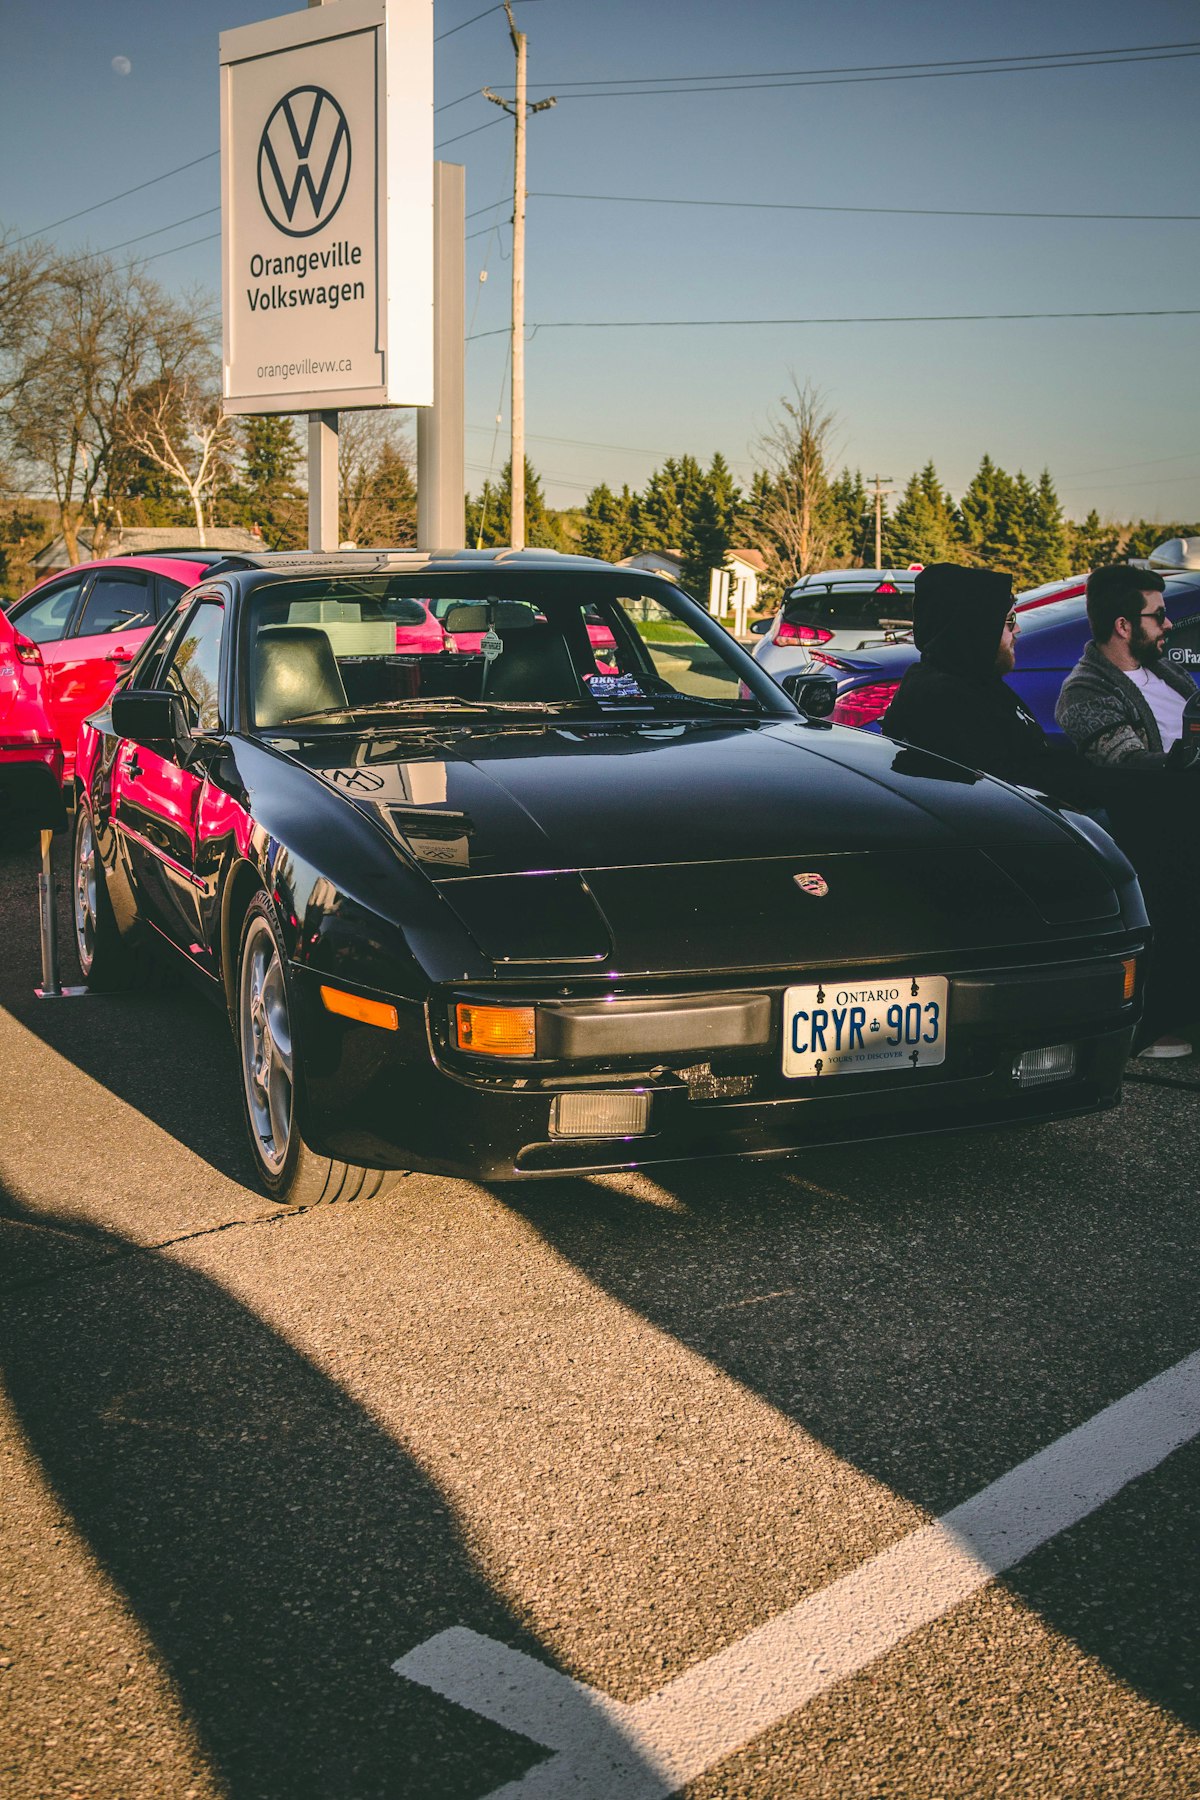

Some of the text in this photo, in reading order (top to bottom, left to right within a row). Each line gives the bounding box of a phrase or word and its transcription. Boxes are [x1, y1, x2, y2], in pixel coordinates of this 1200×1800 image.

[250, 241, 362, 278] Orangeville
[247, 281, 365, 311] Volkswagen
[257, 357, 352, 380] orangevillevw.ca
[792, 1002, 939, 1053] CRYR 903
[828, 1055, 853, 1064] YOURS
[867, 1051, 903, 1061] DISCOVER
